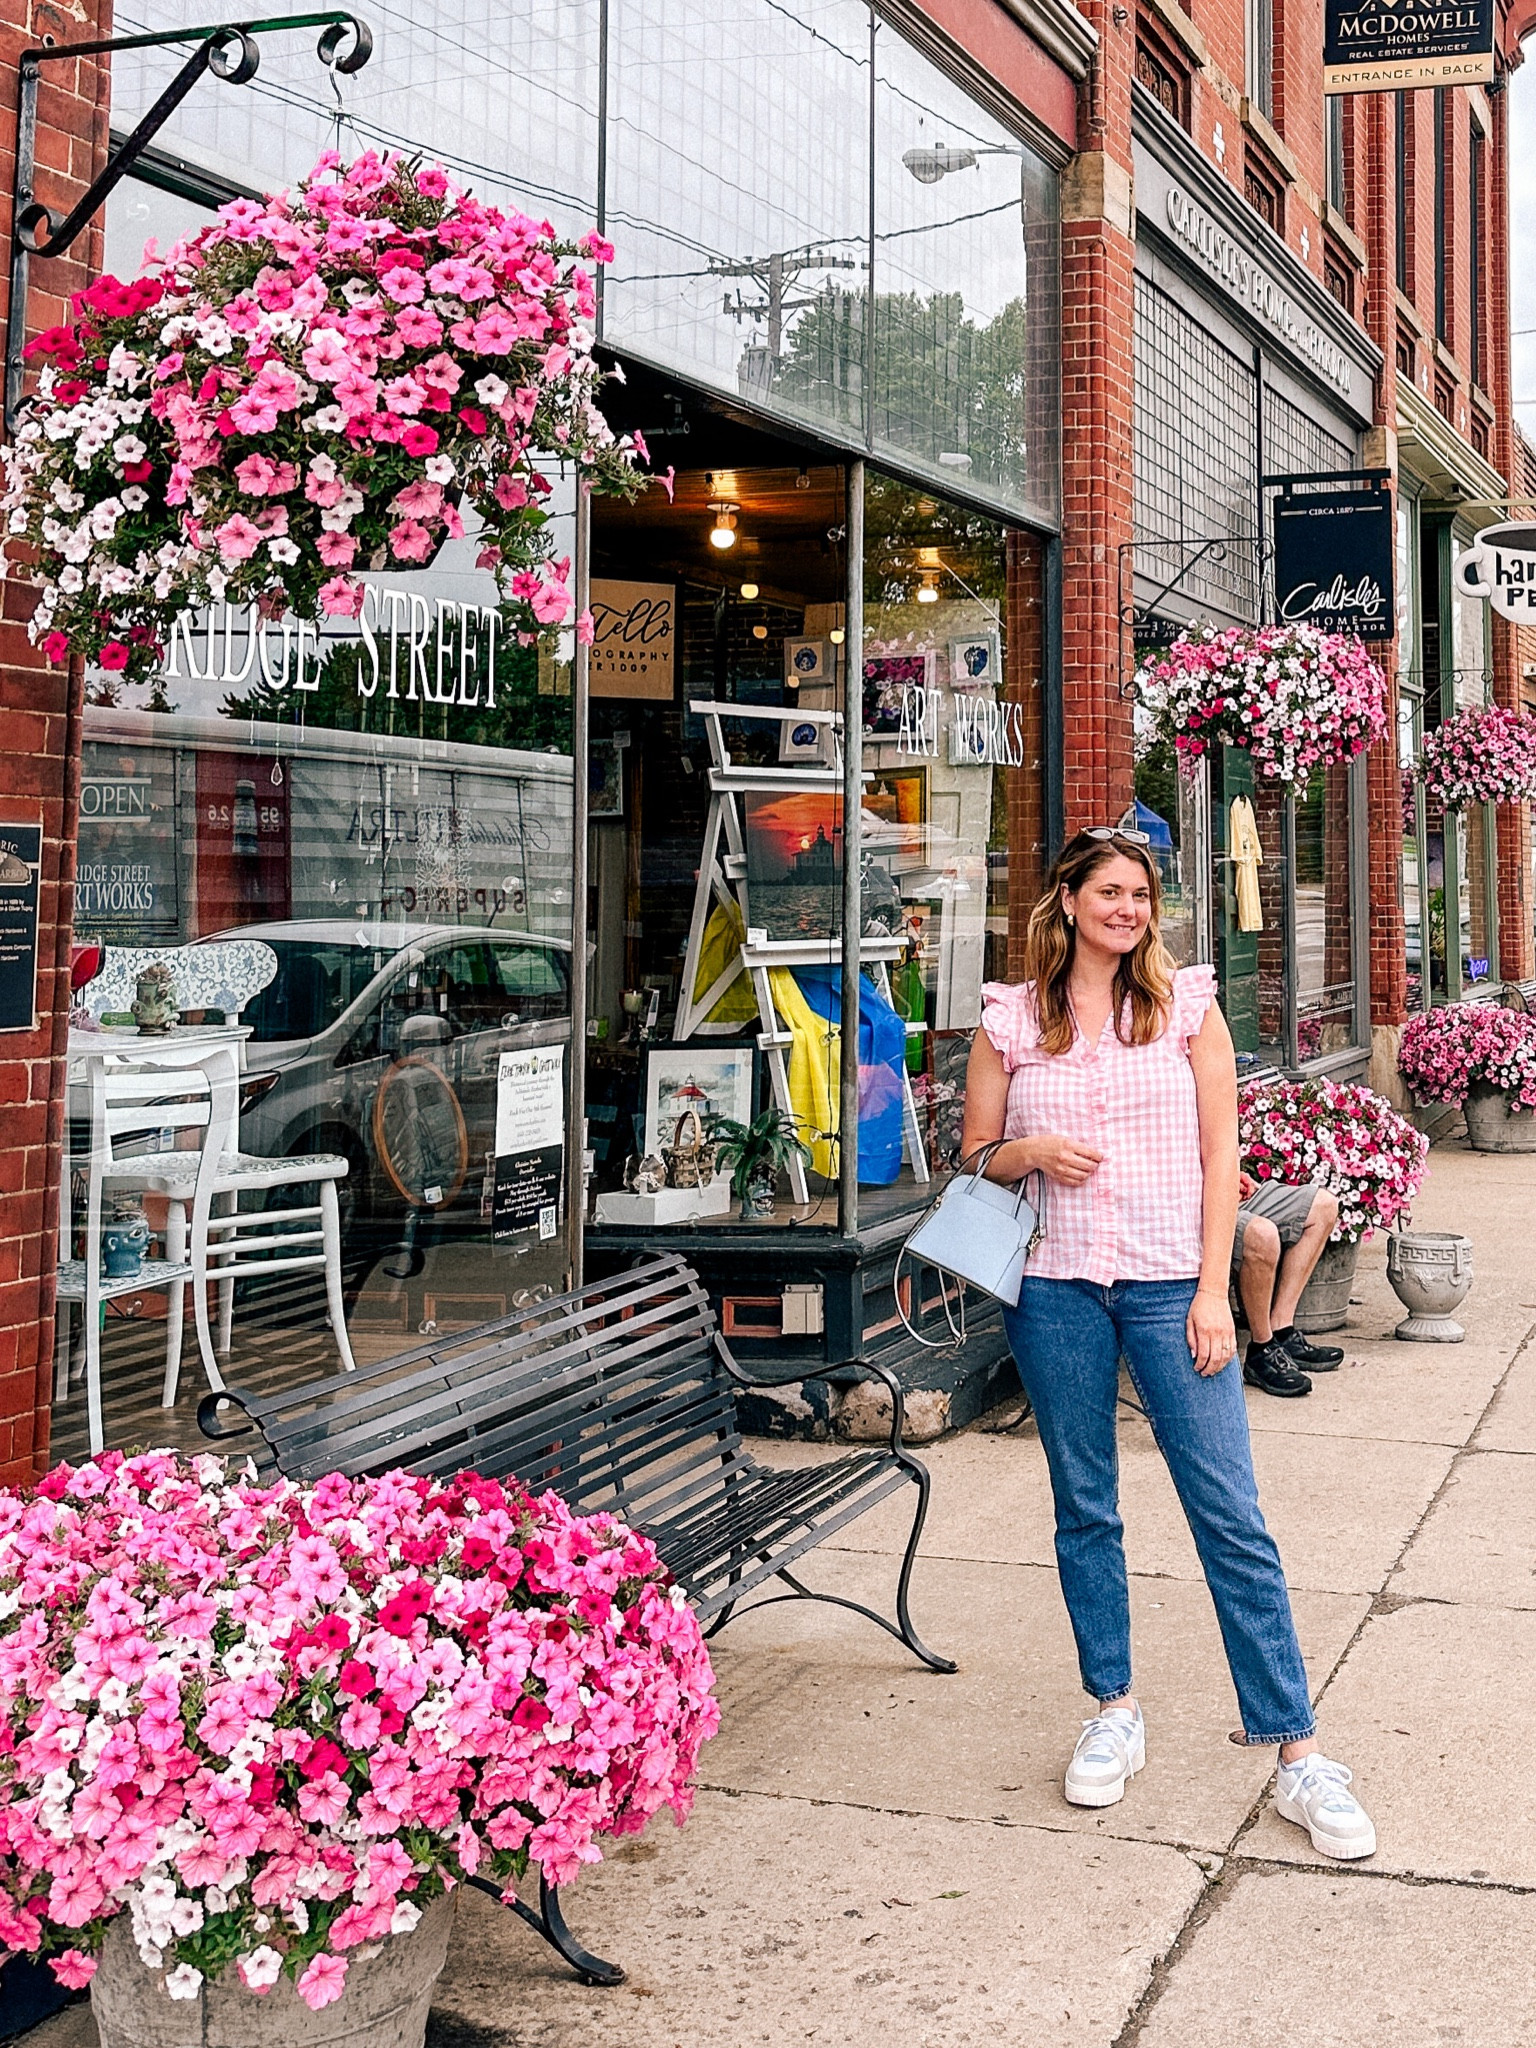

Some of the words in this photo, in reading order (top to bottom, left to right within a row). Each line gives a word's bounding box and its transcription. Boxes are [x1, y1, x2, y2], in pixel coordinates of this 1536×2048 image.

[1387, 33, 1430, 45] HOMES
[1349, 51, 1374, 60] REAL
[1378, 47, 1413, 57] ESTATE
[1417, 43, 1468, 54] SERVICES
[1331, 69, 1413, 84] ENTRANCE
[1420, 67, 1435, 76] IN
[1442, 63, 1484, 75] BACK
[1167, 188, 1250, 295] CARLISLE'S
[1251, 270, 1291, 336] HOME
[1307, 326, 1351, 394] HARBOR
[1308, 508, 1335, 516] CIRCA
[1496, 551, 1536, 586] har
[1282, 574, 1386, 619] Carlisle's
[1507, 588, 1536, 607] PE
[1311, 615, 1358, 626] HOME
[166, 600, 325, 692] RIDGE
[358, 583, 503, 709] STREET
[592, 648, 670, 661] OGRAPHY
[611, 663, 648, 673] 1009
[896, 683, 942, 757] ART
[953, 692, 1024, 768] WORKS
[80, 785, 145, 815] OPEN
[1, 840, 19, 854] RIC
[0, 868, 29, 880] ARBOR
[75, 864, 107, 882] RIDGE
[111, 864, 150, 882] STREET
[74, 883, 93, 911] RT
[96, 882, 153, 911] WORKS
